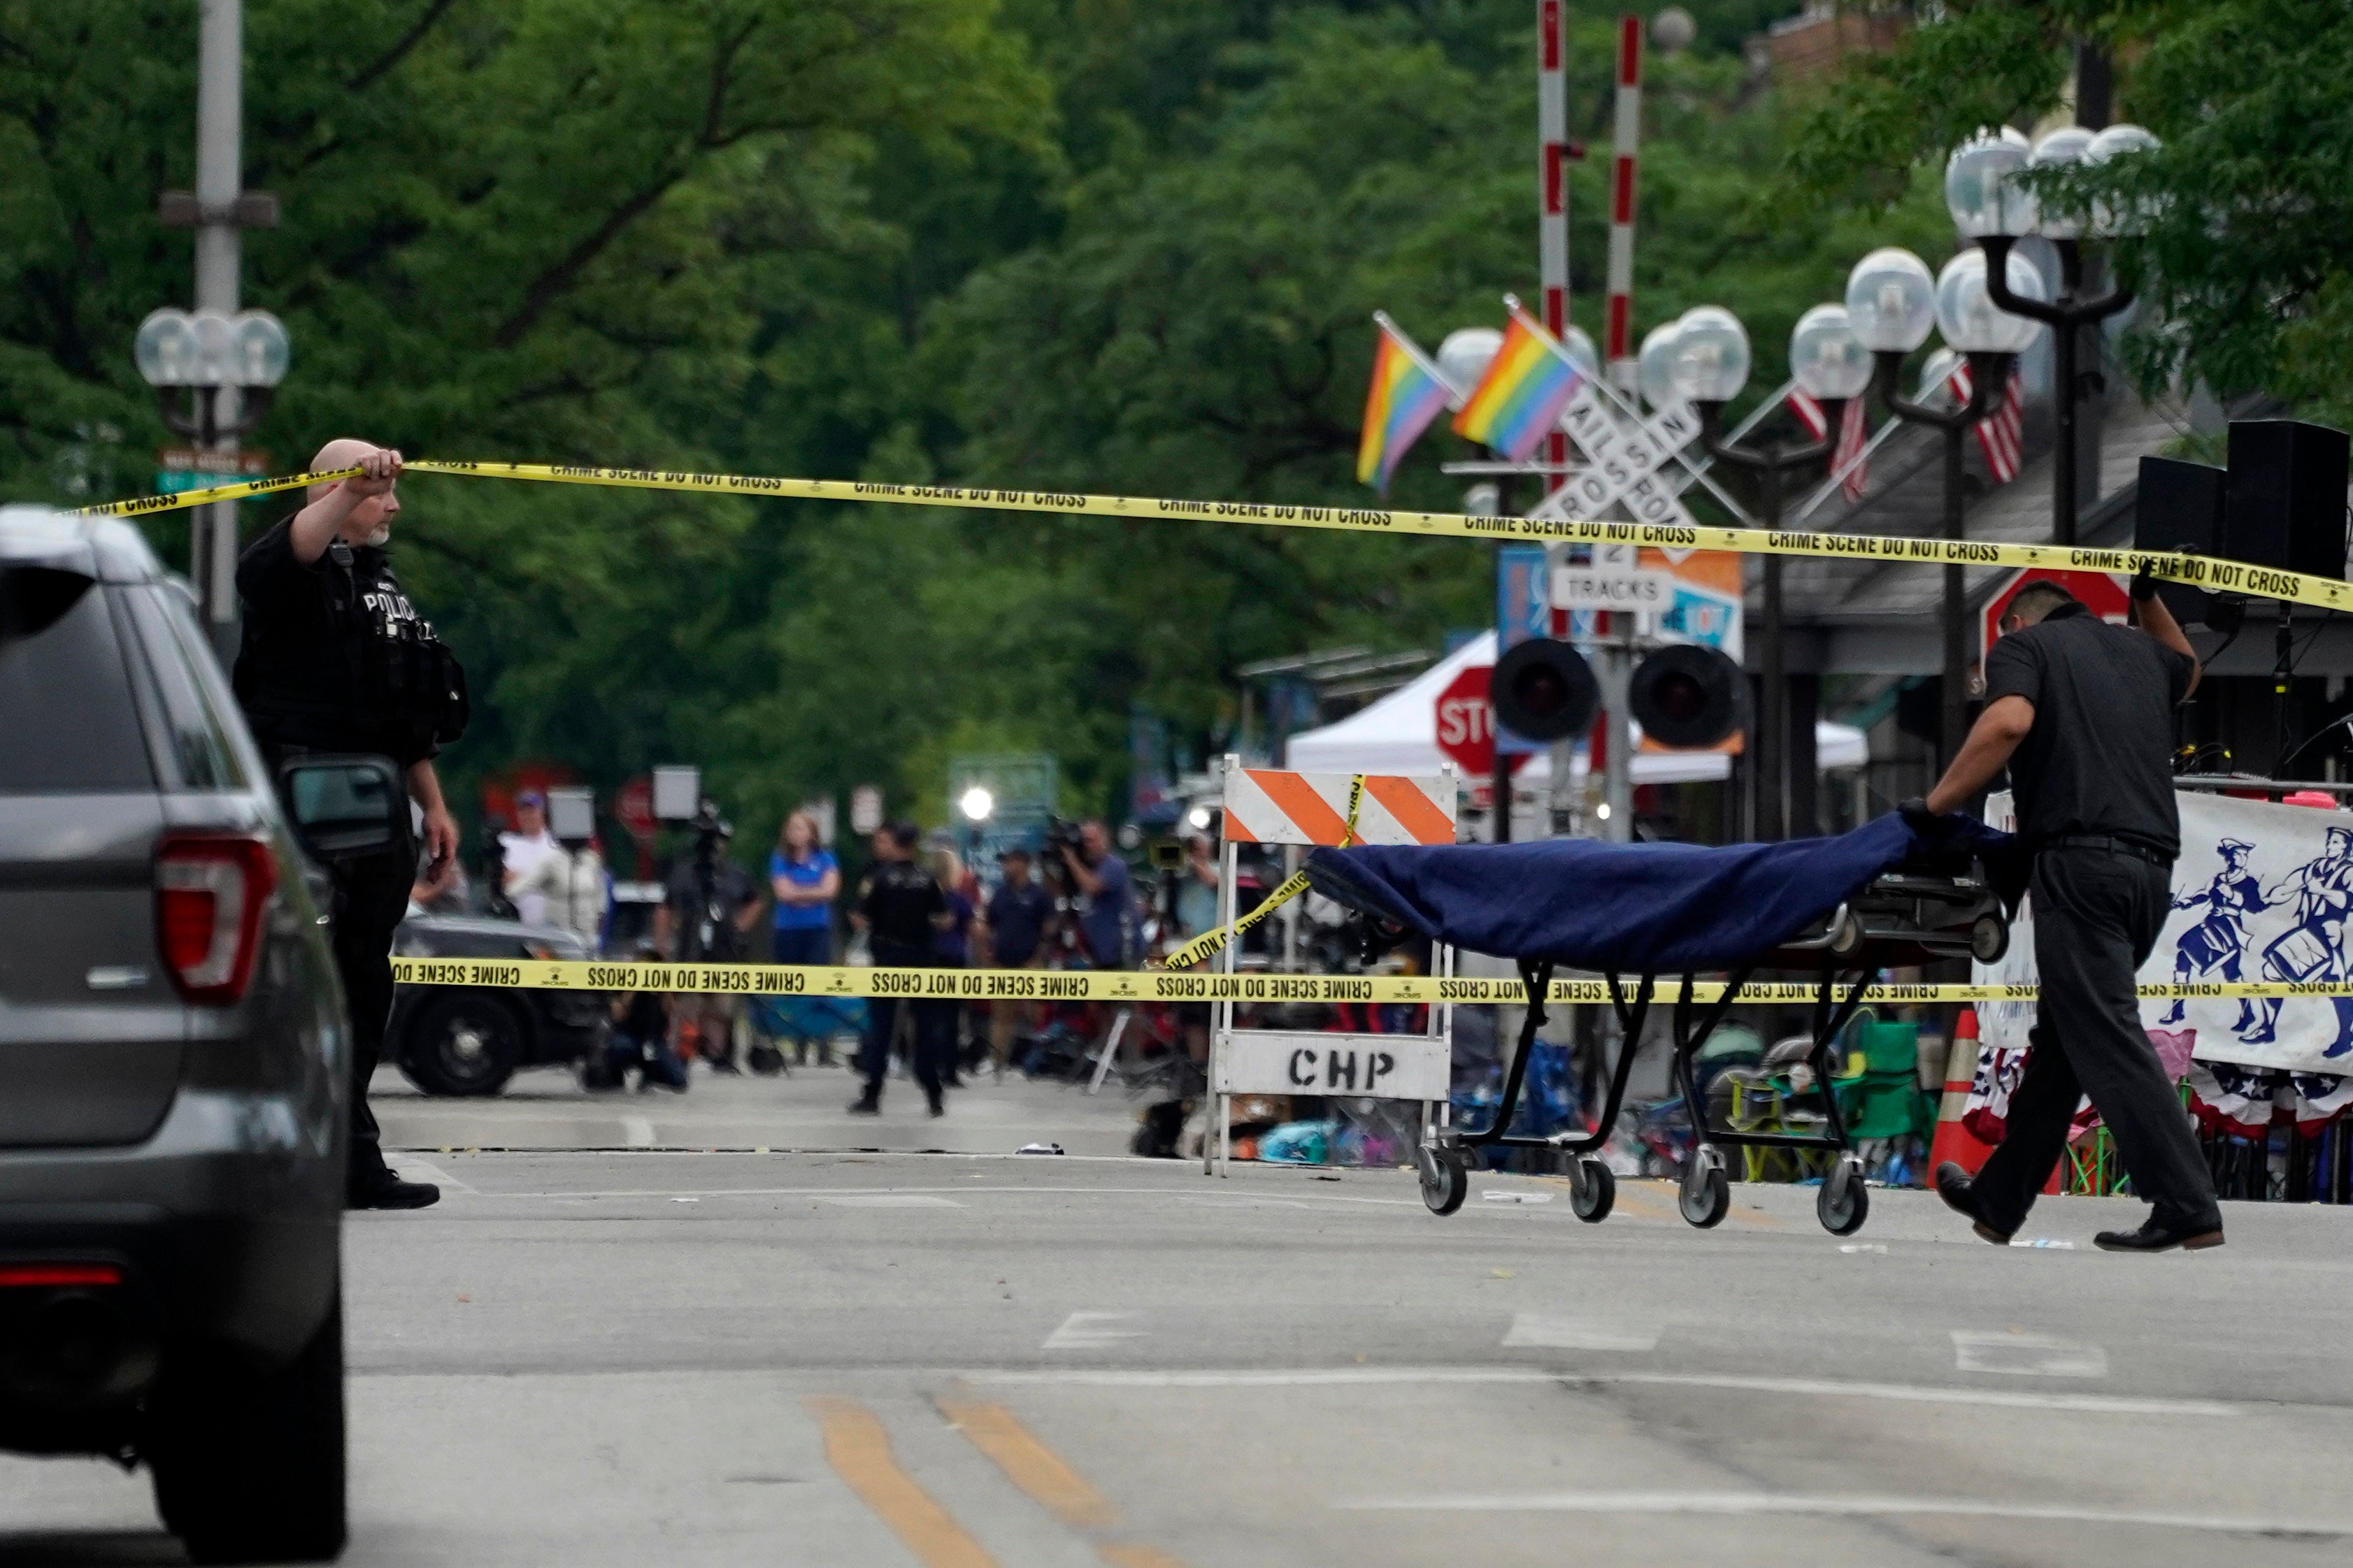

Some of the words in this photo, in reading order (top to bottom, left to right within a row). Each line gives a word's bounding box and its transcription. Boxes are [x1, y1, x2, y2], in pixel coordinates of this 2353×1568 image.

[1541, 396, 1701, 521] ROSSIN
[550, 464, 602, 477] CRIME
[608, 468, 659, 482] SCENE
[665, 473, 686, 484] DO
[692, 474, 722, 486] NOT
[729, 475, 782, 489] CROSS
[854, 482, 906, 496] CRIME
[913, 486, 963, 500] SCENE
[969, 490, 989, 502] DO
[996, 491, 1027, 505] NOT
[1033, 494, 1086, 508] CROSS
[1159, 499, 1210, 513] CRIME
[1216, 503, 1268, 518] SCENE
[1274, 506, 1295, 519] DO
[1301, 507, 1331, 522] NOT
[1338, 510, 1392, 526] CROSS
[1464, 516, 1517, 533] CRIME
[1522, 519, 1573, 535] SCENE
[1580, 522, 1601, 538] DO
[1608, 524, 1637, 540] NOT
[1643, 526, 1696, 544] CROSS
[1768, 532, 1820, 549] CRIME
[1826, 535, 1877, 554] SCENE
[1883, 539, 1904, 556] DO
[1910, 540, 1940, 558] NOT
[1946, 542, 1999, 561] CROSS
[2071, 549, 2122, 569] CRIME
[2127, 554, 2180, 577] SCENE
[2184, 560, 2206, 581] DO
[2210, 563, 2244, 587] NOT
[2247, 570, 2301, 597] CROSS
[1569, 580, 1661, 601] TRACKS
[363, 593, 415, 621] POLIC
[1440, 699, 1497, 746] ST
[1193, 936, 1220, 961] NOT
[393, 963, 412, 981] DO
[417, 965, 465, 983] SCENE
[471, 967, 520, 986] CRIME
[587, 968, 637, 987] CROSS
[642, 970, 671, 988] NOT
[677, 970, 696, 988] DO
[701, 970, 750, 990] SCENE
[755, 972, 805, 991] CRIME
[871, 972, 921, 993] CROSS
[926, 974, 956, 994] NOT
[962, 975, 980, 994] DO
[987, 975, 1035, 995] SCENE
[1039, 977, 1089, 996] CRIME
[1157, 977, 1206, 996] CROSS
[1210, 977, 1240, 997] NOT
[1245, 979, 1265, 998] DO
[1270, 979, 1317, 998] SCENE
[1323, 980, 1372, 999] CRIME
[1440, 980, 1489, 998] CROSS
[1494, 981, 1523, 999] NOT
[1554, 982, 1602, 1000] SCENE
[1724, 984, 1772, 999] CRO
[1777, 984, 1805, 998] NOT
[1837, 984, 1884, 999] SCNE
[1890, 985, 1938, 998] CRIME
[1289, 1049, 1395, 1091] CHP
